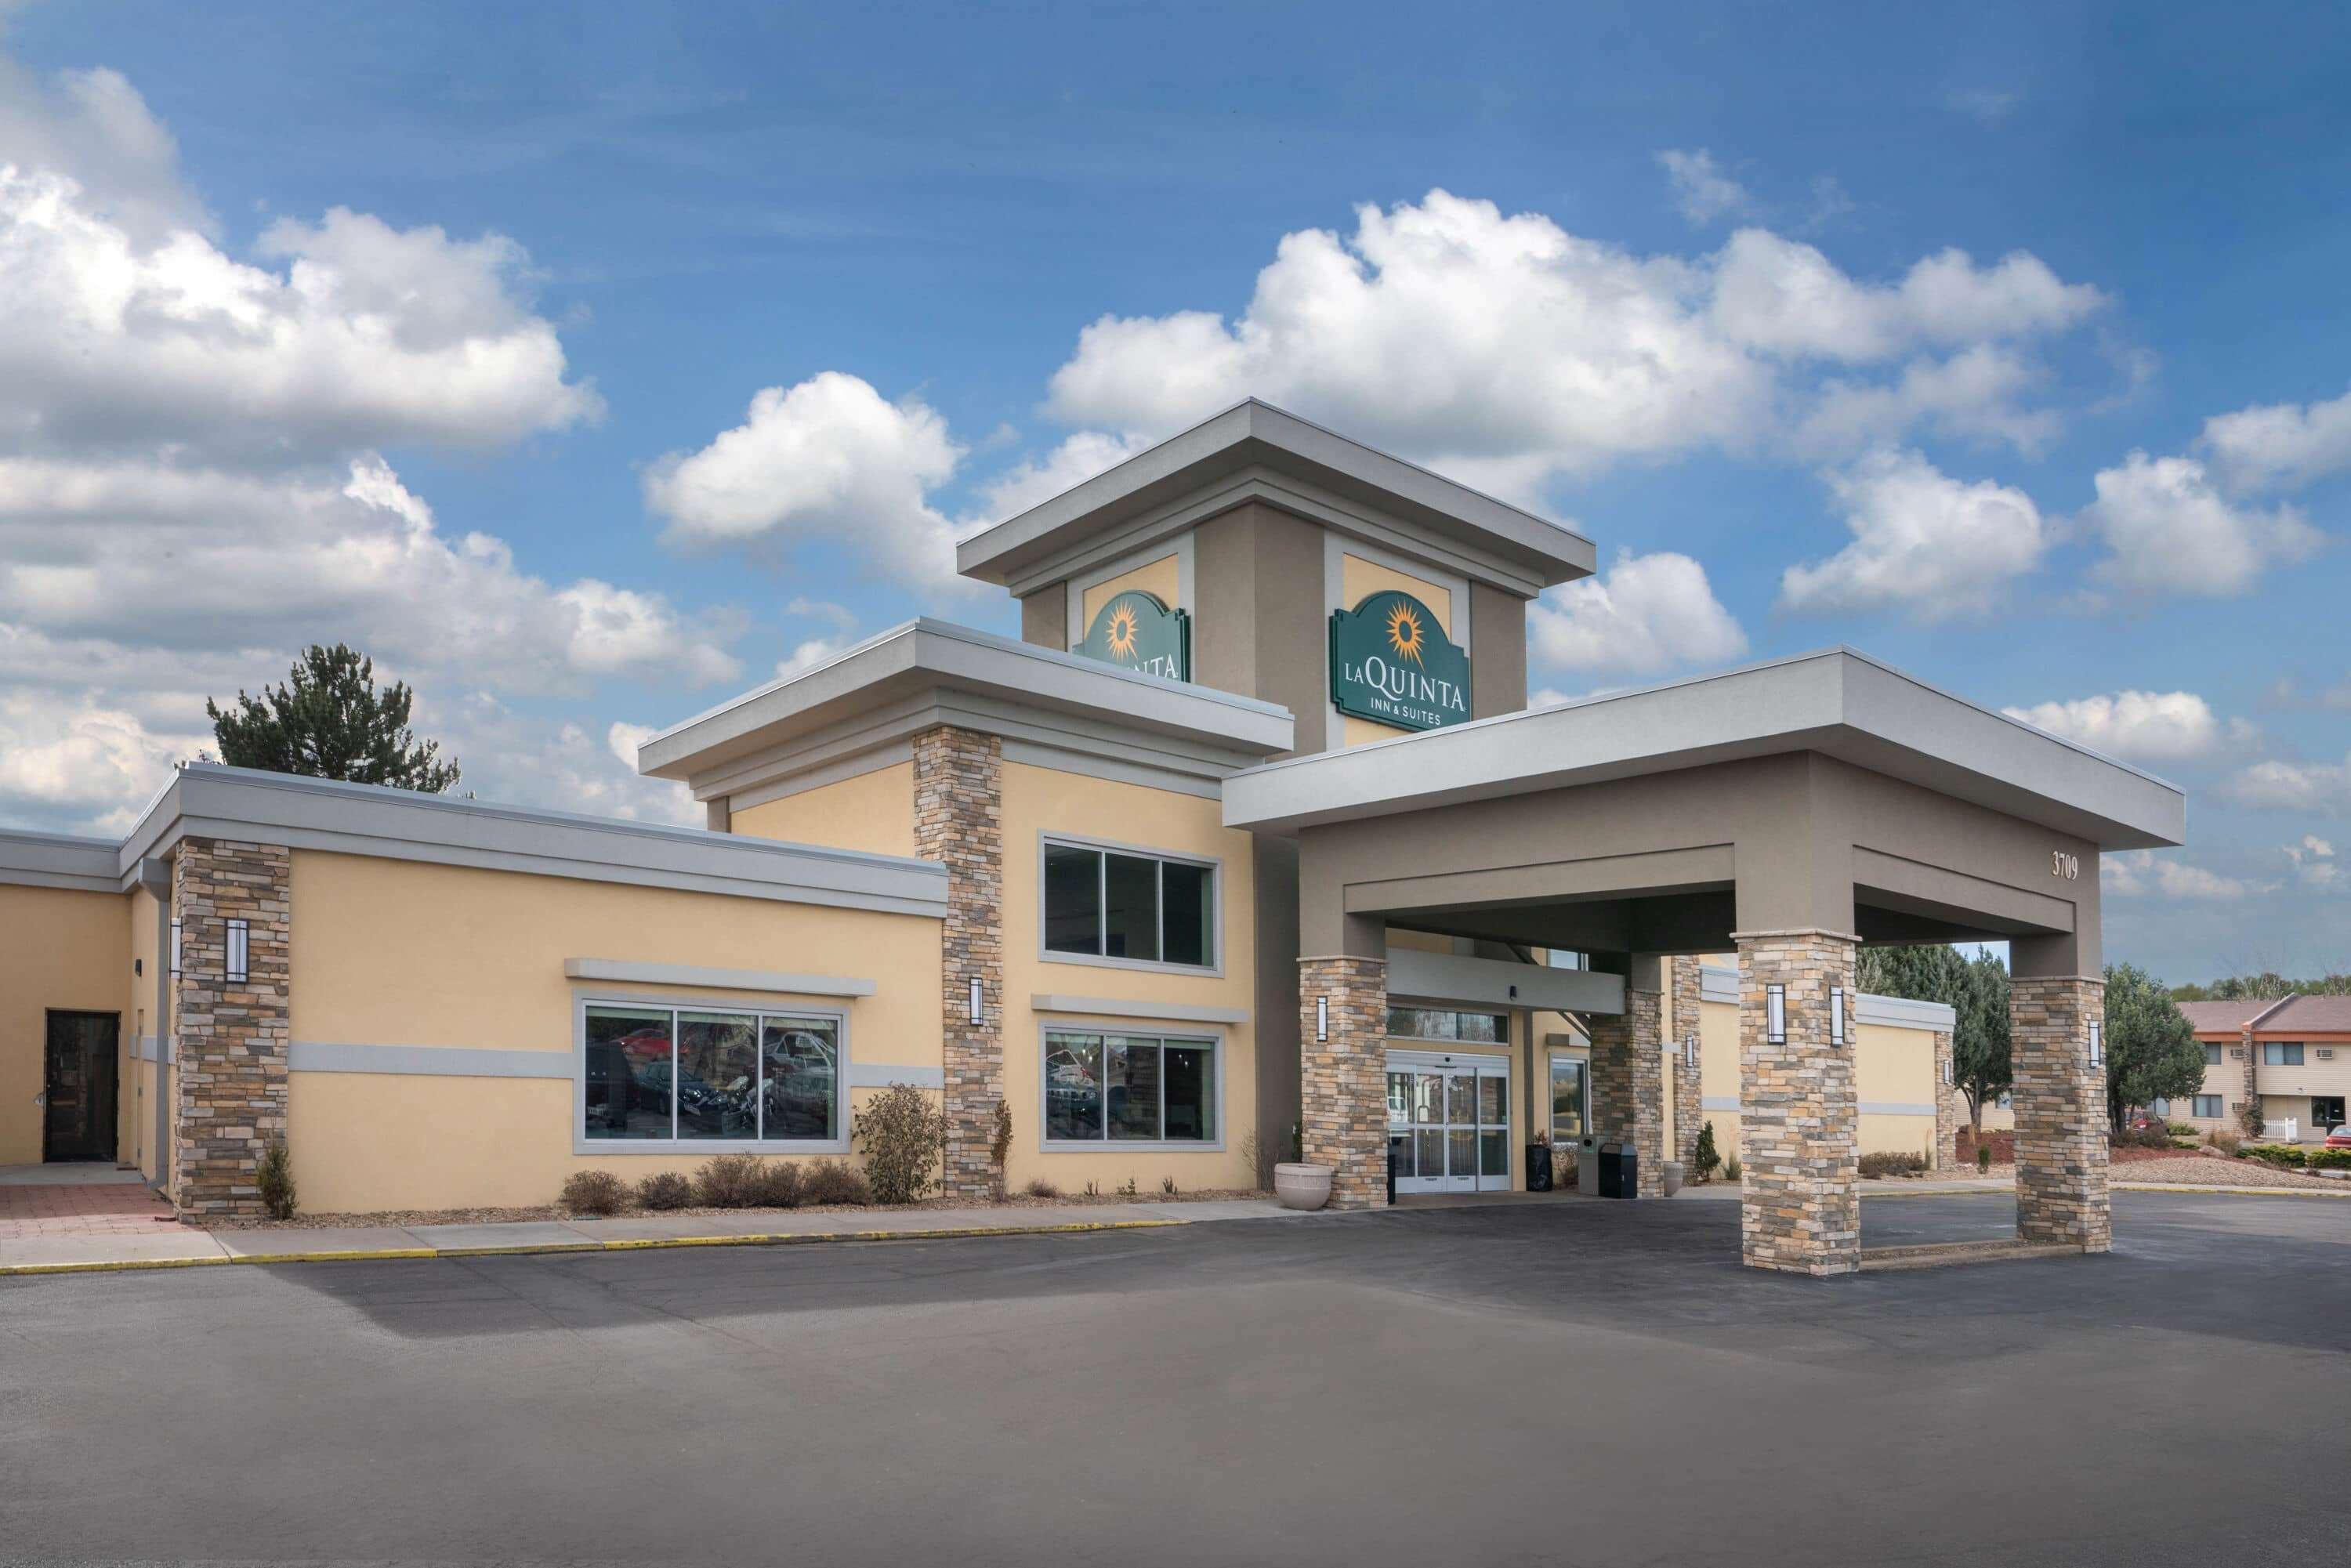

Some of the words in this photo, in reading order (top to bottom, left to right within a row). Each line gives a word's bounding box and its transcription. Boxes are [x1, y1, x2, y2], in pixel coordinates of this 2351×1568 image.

[1345, 663, 1364, 684] LA
[1365, 656, 1466, 712] QUINTA
[1371, 697, 1390, 712] INN
[1393, 705, 1400, 715] &
[1402, 706, 1441, 726] SUITES
[2052, 850, 2078, 880] 3709
